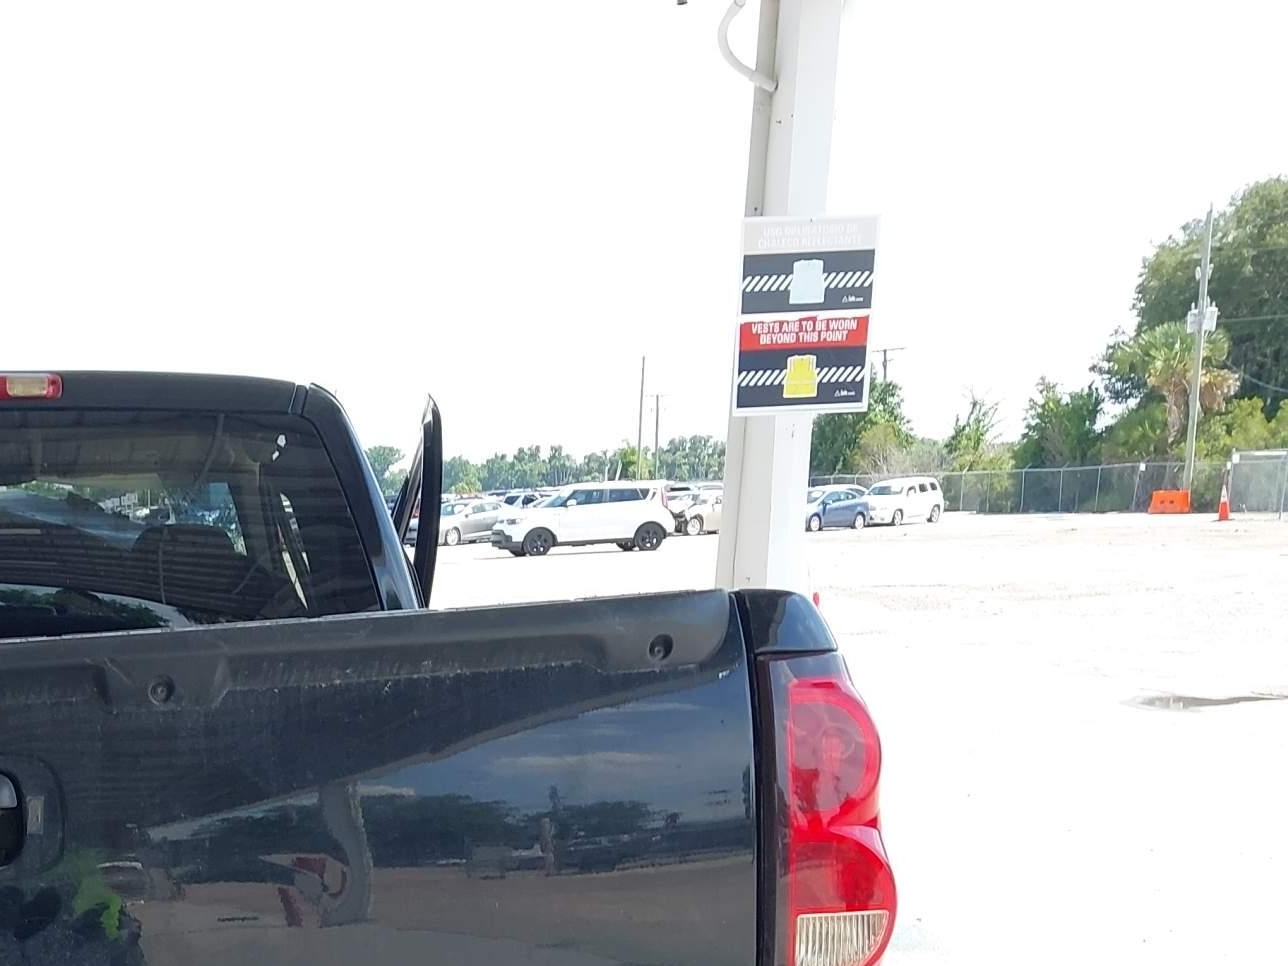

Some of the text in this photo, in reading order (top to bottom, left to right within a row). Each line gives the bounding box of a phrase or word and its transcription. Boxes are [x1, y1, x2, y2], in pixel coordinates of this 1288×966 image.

[752, 319, 858, 334] VESTS ARE TO BE WORN
[760, 330, 849, 345] BEYOND THIS POINT
